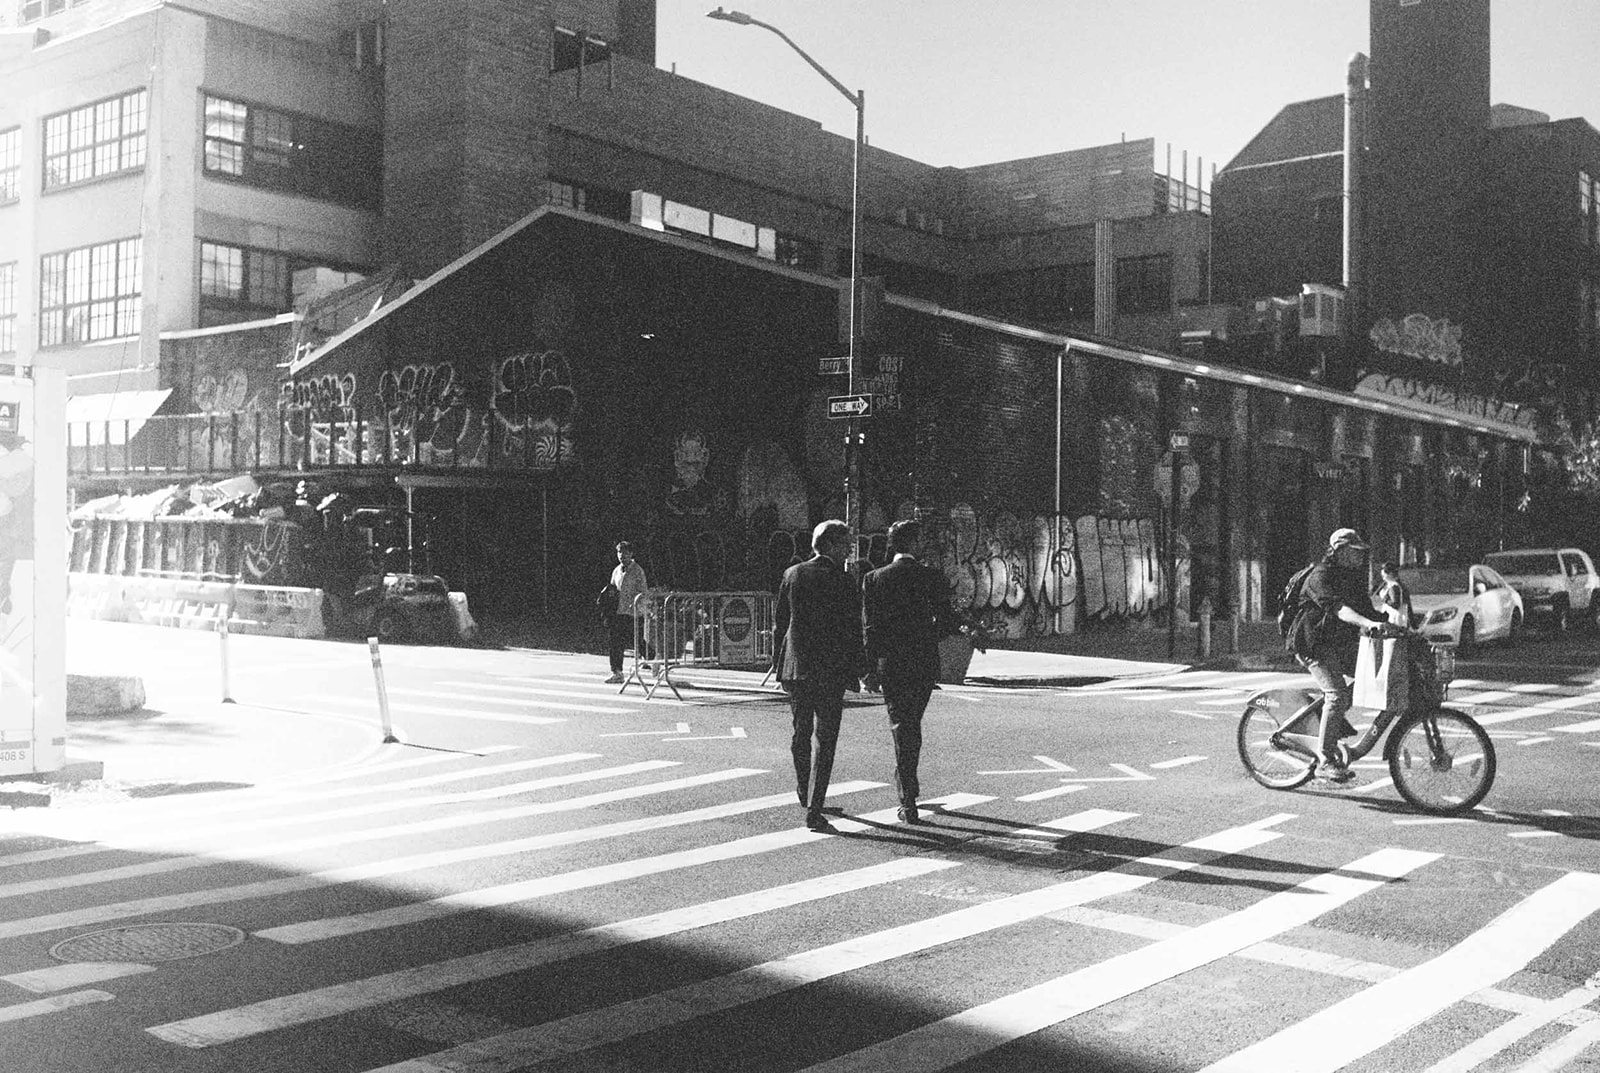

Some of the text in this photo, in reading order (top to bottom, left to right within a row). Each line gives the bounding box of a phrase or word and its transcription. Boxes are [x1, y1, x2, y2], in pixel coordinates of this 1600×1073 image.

[819, 360, 841, 373] Berry
[879, 356, 905, 372] COST
[834, 401, 865, 412] ONE WAY
[19, 750, 26, 760] S
